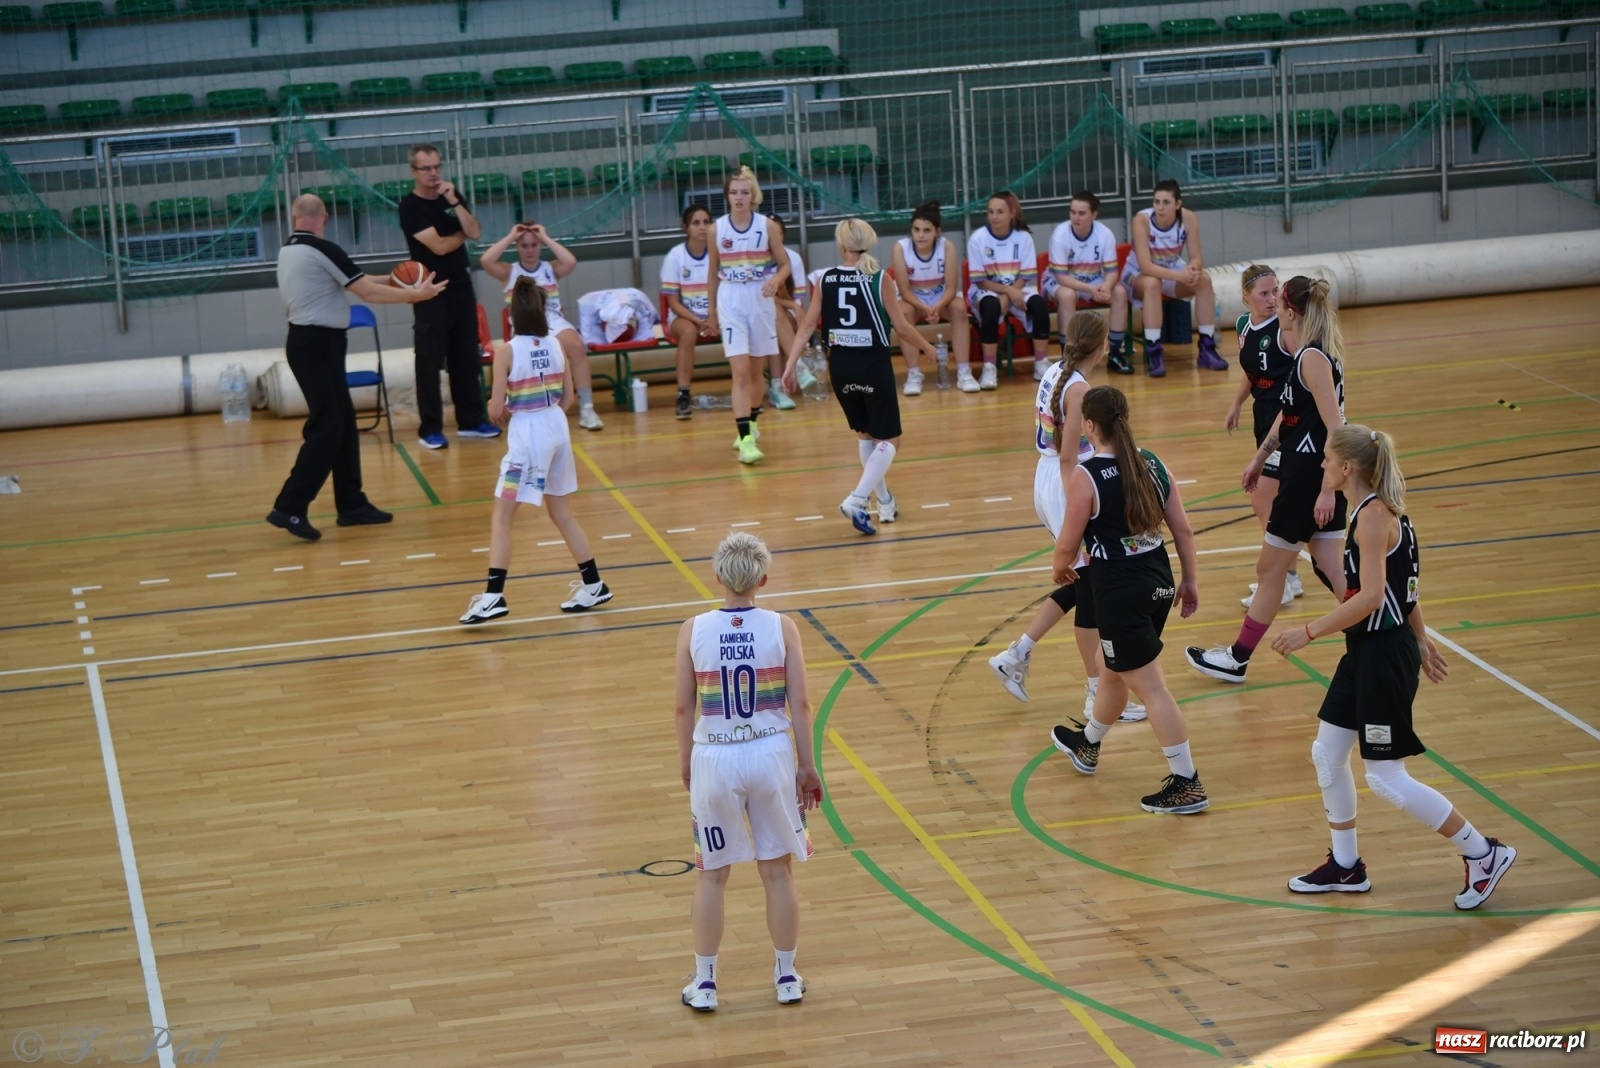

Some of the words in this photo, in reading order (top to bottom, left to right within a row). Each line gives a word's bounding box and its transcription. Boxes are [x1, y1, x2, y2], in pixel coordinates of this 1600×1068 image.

[756, 231, 763, 248] 7
[1094, 246, 1100, 261] 5
[825, 274, 838, 283] RKK
[840, 274, 873, 283] RACIBORZ
[838, 287, 858, 327] 5
[726, 327, 733, 344] 7
[1258, 351, 1268, 371] 3
[1100, 465, 1119, 480] RKK
[719, 632, 755, 644] KAMIENICA
[720, 645, 755, 661] POLSKA
[721, 664, 756, 720] 10
[708, 732, 733, 743] DEN
[752, 726, 777, 740] MED
[704, 826, 726, 852] 10
